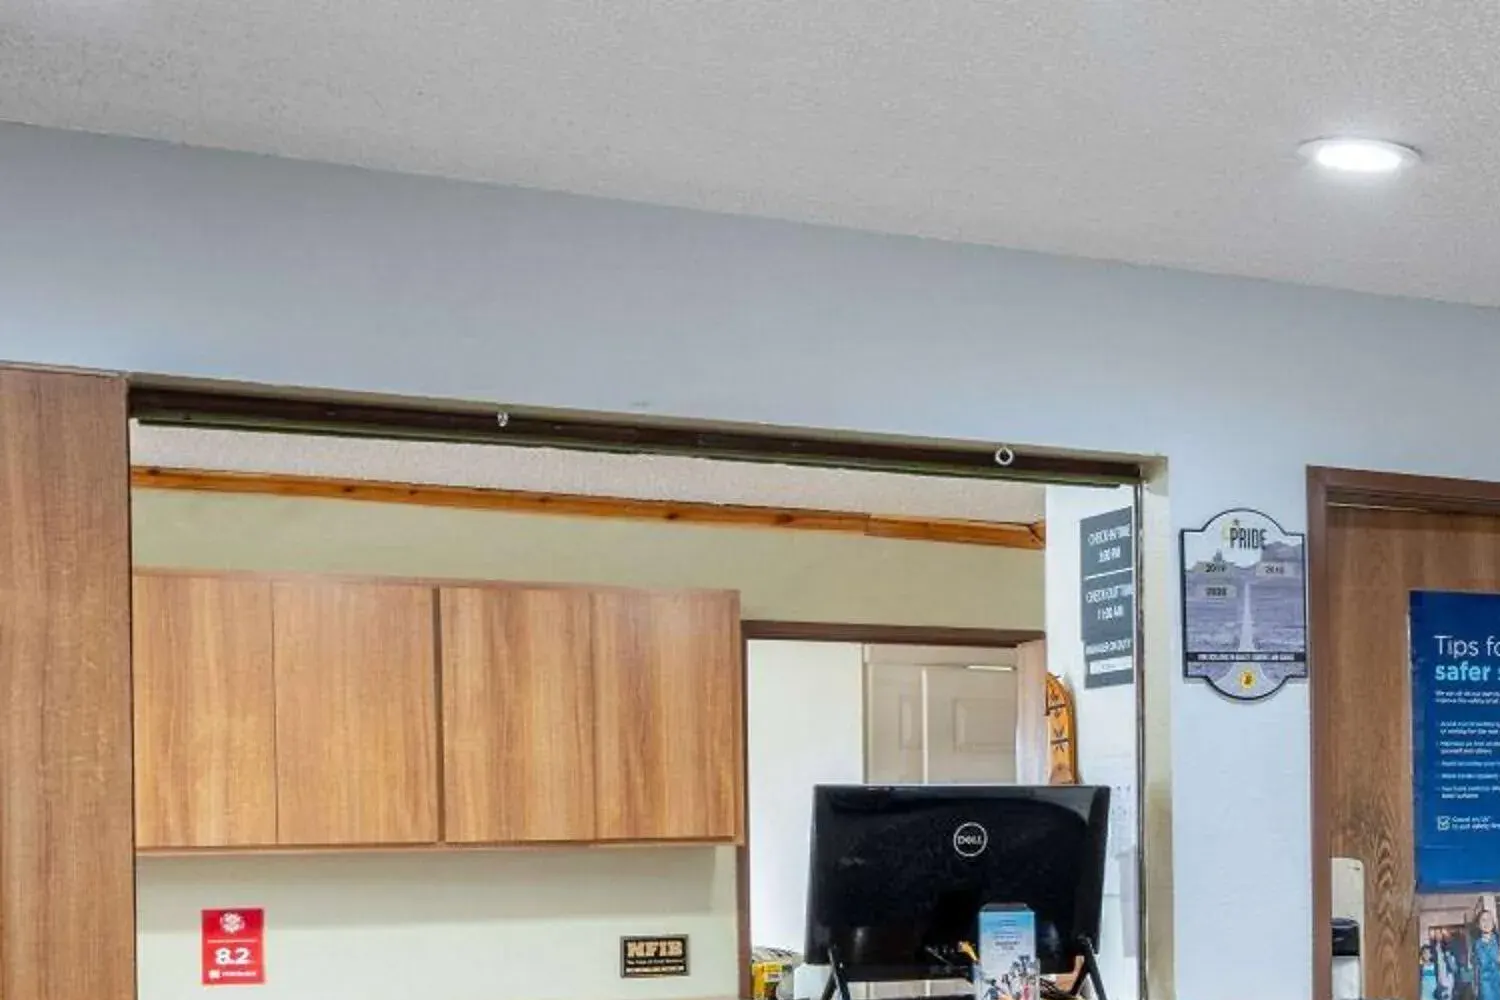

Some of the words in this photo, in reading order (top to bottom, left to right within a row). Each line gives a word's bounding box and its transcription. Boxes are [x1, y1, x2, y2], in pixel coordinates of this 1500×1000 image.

[1229, 527, 1268, 550] PRIDE
[1433, 635, 1479, 658] Tips
[1434, 661, 1491, 682] safer
[957, 835, 982, 845] DELL
[215, 947, 253, 965] 8.2
